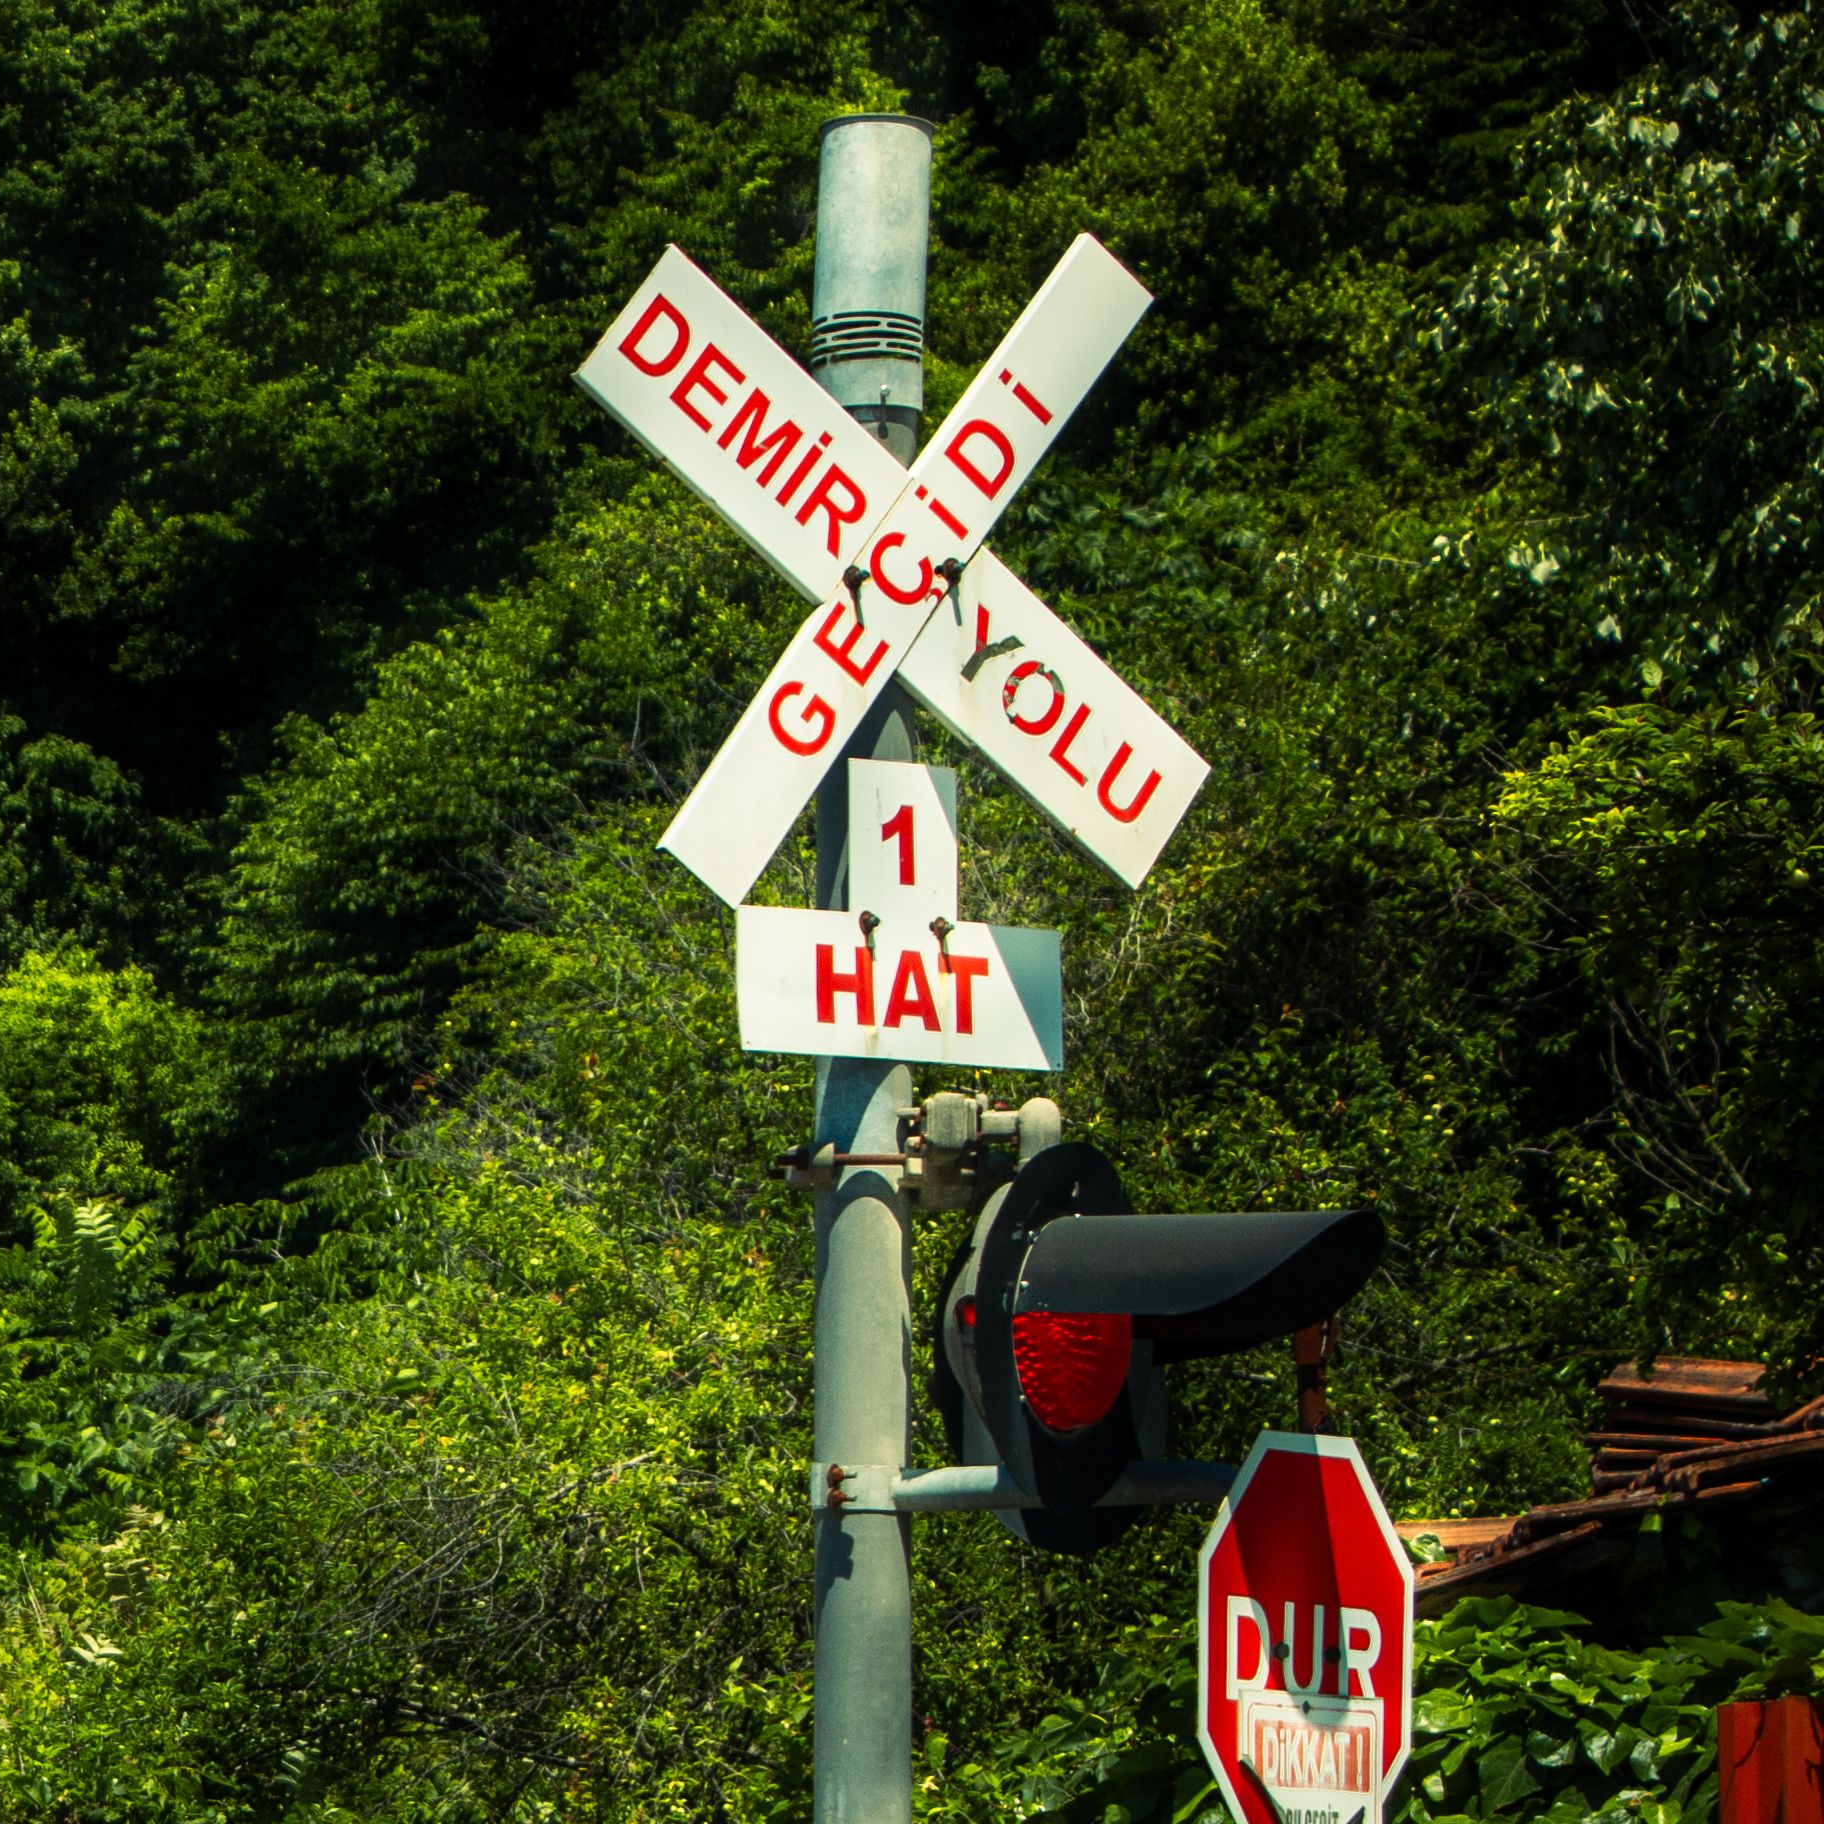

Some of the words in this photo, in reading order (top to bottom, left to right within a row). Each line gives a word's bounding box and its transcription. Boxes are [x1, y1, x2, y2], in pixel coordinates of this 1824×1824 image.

[617, 292, 868, 560] DEMİR
[960, 602, 1163, 825] YOLU
[881, 804, 916, 887] 1
[815, 943, 990, 1035] HAT
[1226, 1595, 1382, 1700] DUR
